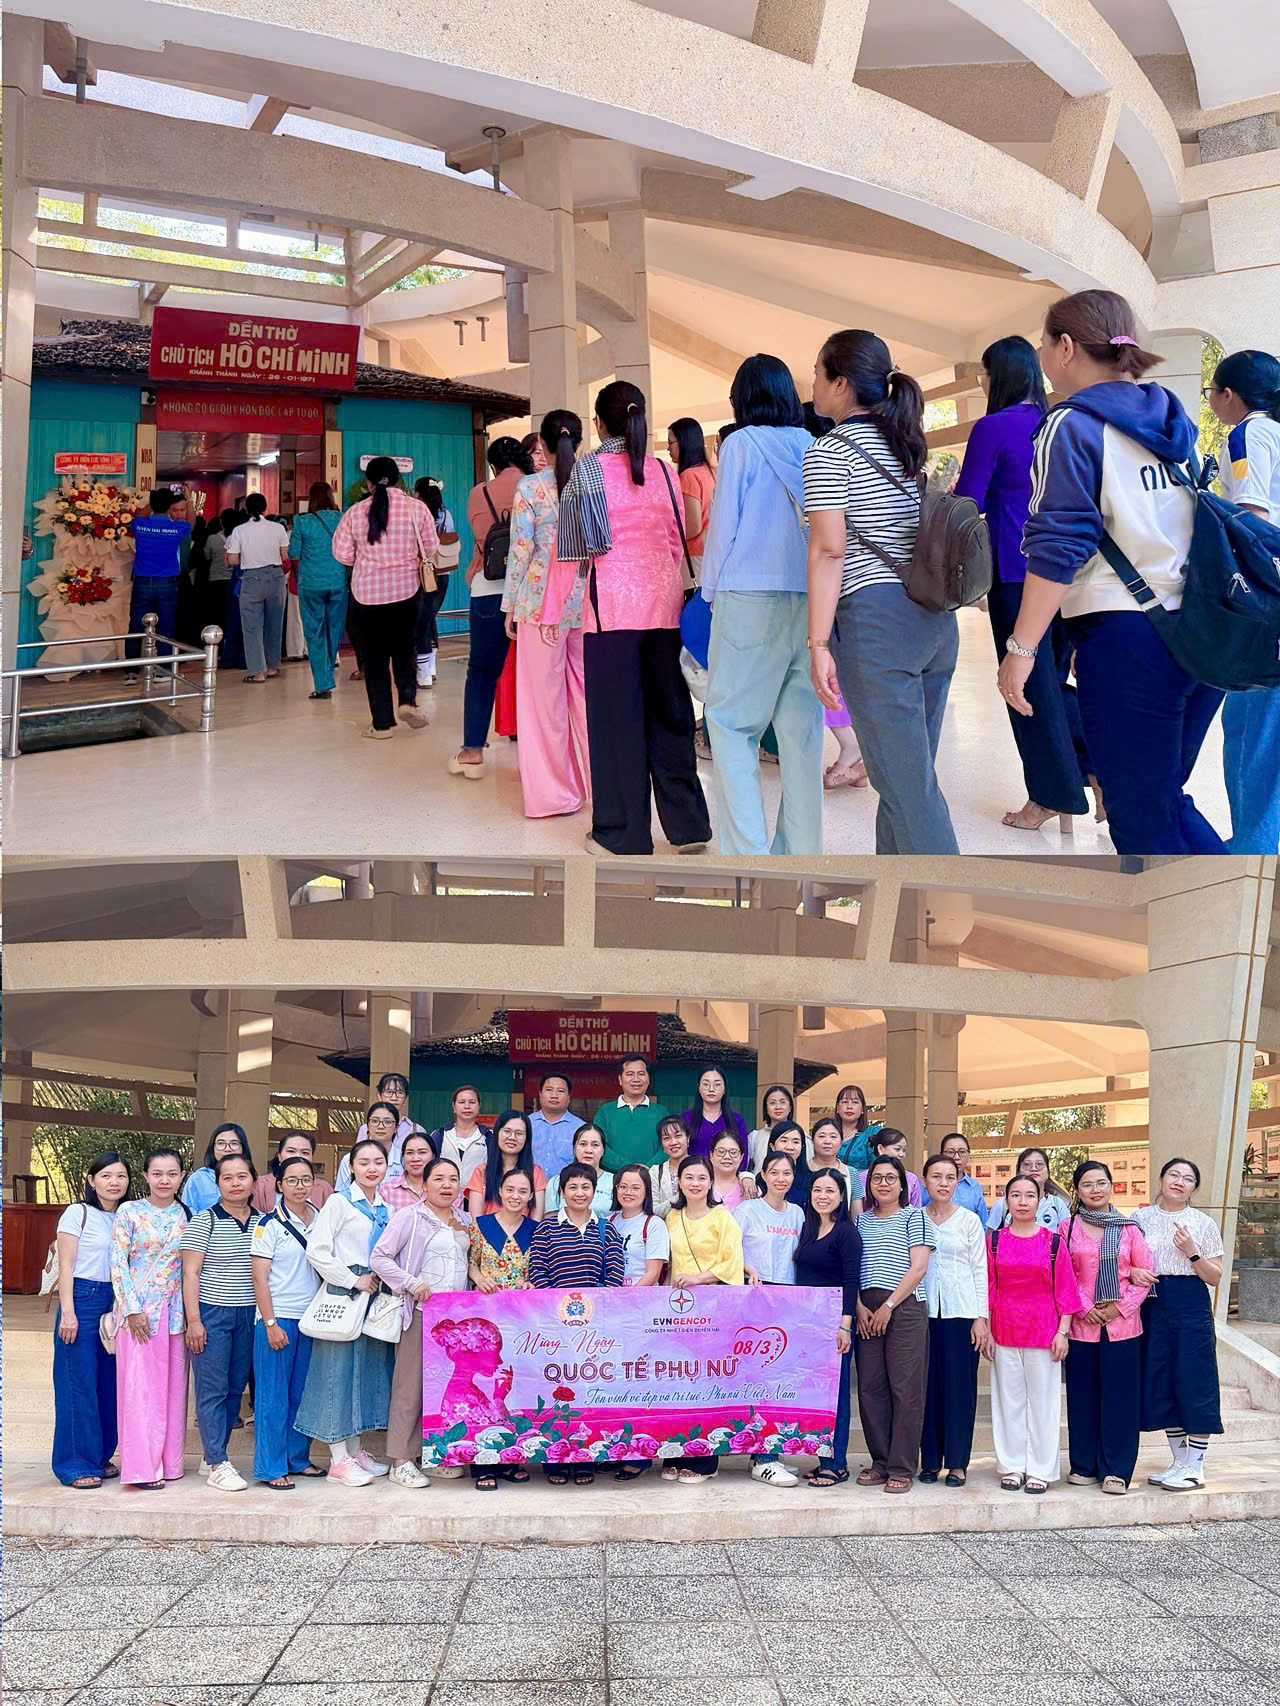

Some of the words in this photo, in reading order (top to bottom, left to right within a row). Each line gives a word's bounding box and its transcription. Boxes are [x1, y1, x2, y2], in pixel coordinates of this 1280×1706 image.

[228, 319, 264, 339] ĐỀN
[265, 326, 299, 341] THỜ
[160, 343, 185, 365] CHỦ
[187, 346, 214, 369] TỊCH
[219, 339, 255, 369] HỒ
[189, 368, 213, 377] KHÁNH
[215, 370, 238, 378] THÀNH
[559, 1015, 584, 1029] ĐỀN
[585, 1016, 610, 1029] THỜ
[555, 1030, 578, 1051] HỒ
[653, 1317, 712, 1325] EVNGENCO1
[571, 1329, 622, 1354] Ngày
[732, 1339, 771, 1356] 08/3
[544, 1354, 614, 1383] QUỐC
[621, 1353, 649, 1379] TẾ
[654, 1360, 699, 1382] PHỤ
[706, 1354, 740, 1378] NỮ
[765, 1384, 797, 1400] Nam
